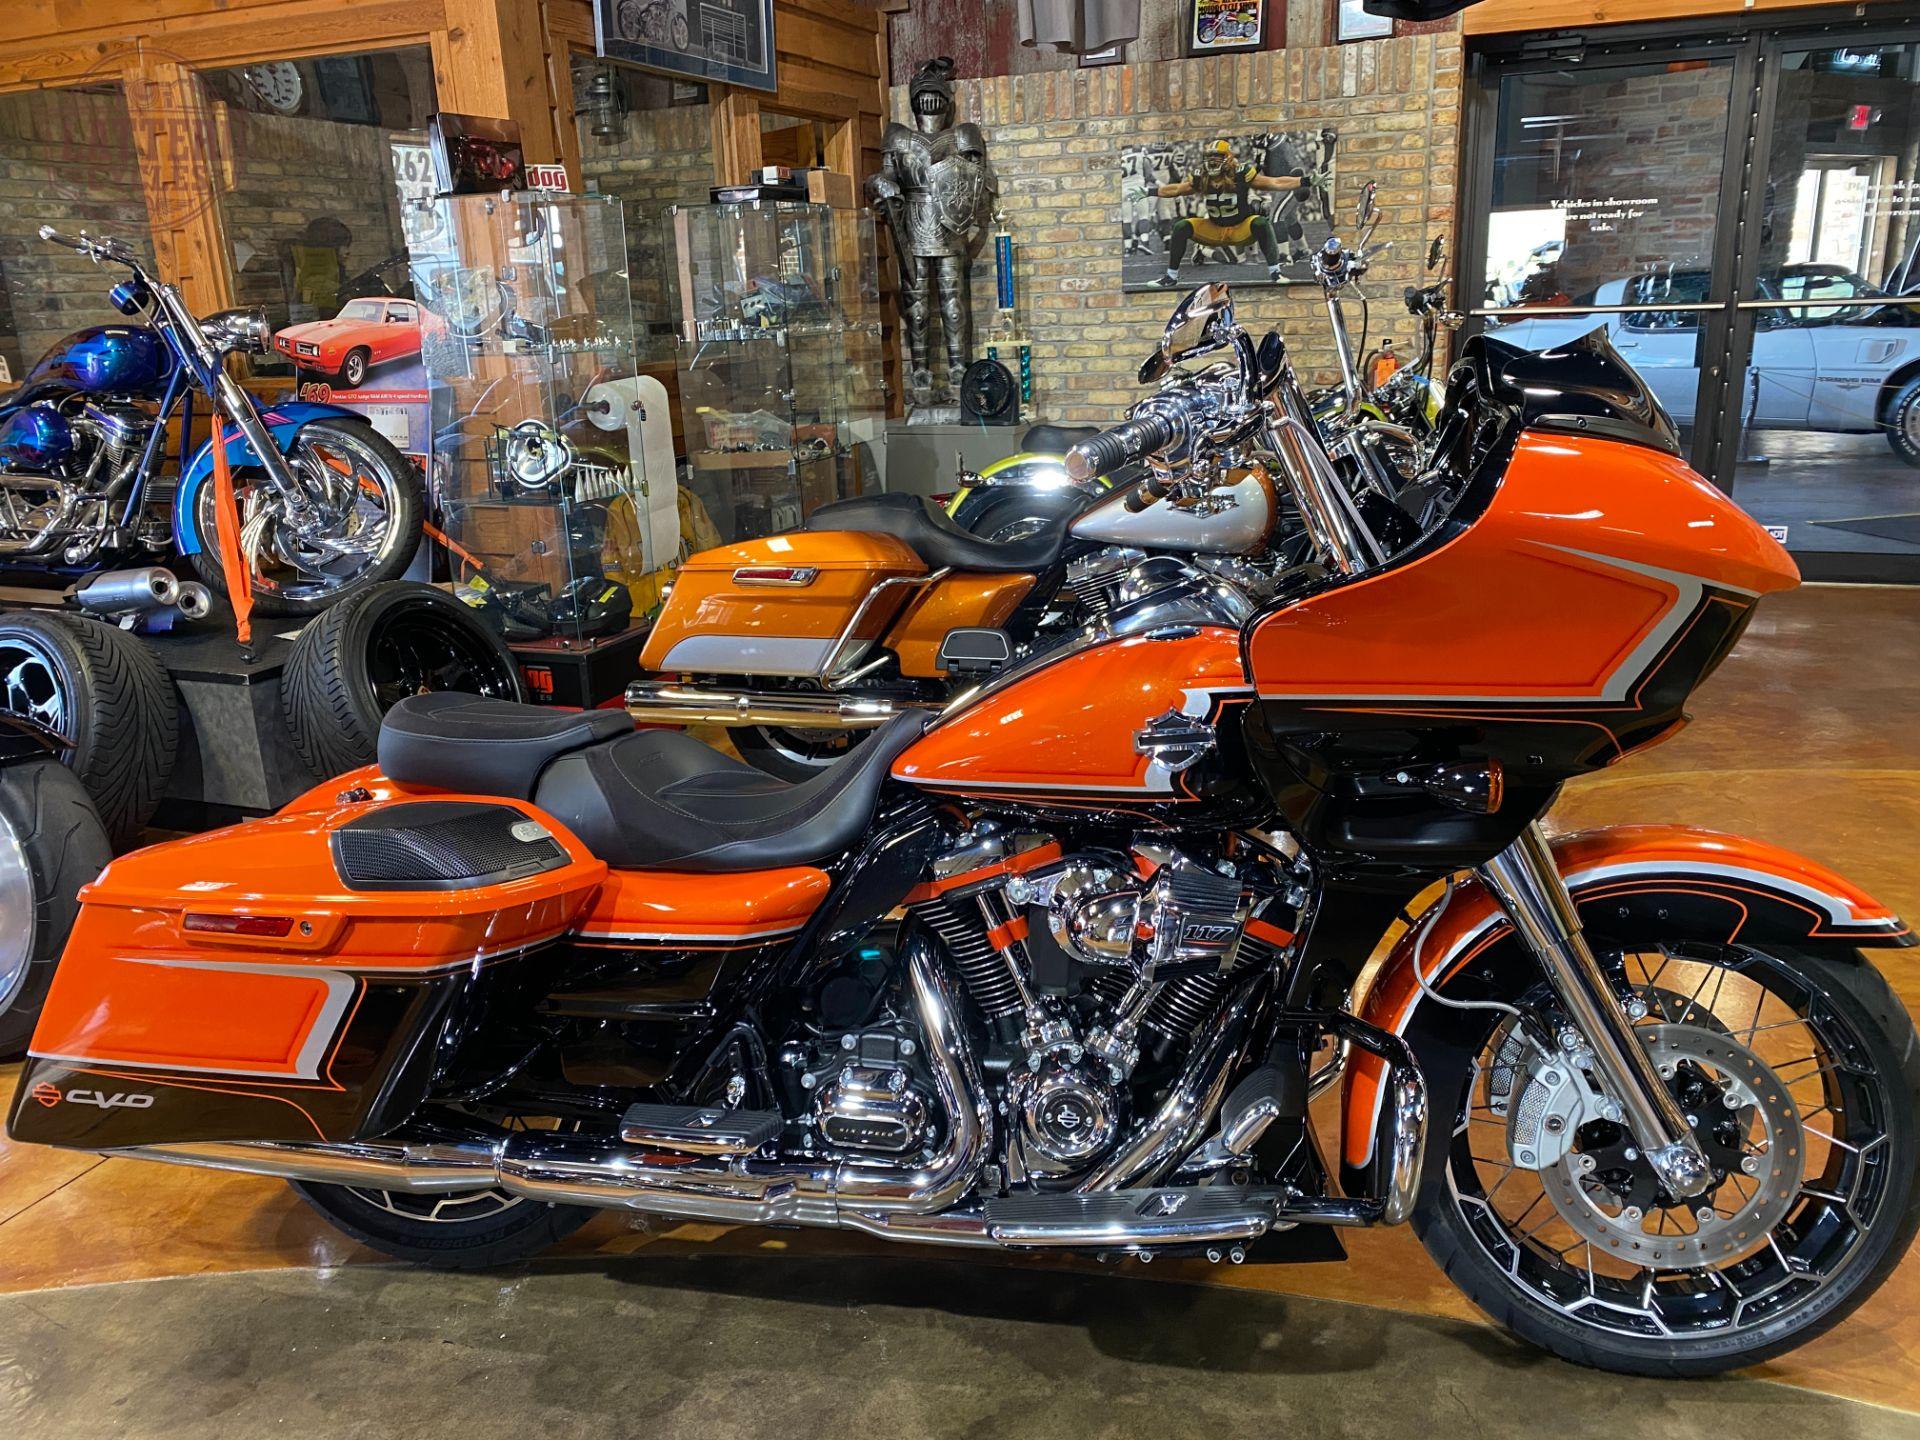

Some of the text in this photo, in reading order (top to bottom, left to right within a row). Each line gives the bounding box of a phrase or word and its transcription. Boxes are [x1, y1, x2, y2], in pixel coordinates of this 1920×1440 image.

[527, 166, 567, 191] dog
[1205, 193, 1239, 218] 52
[1550, 197, 1658, 209] Vehicles in showroom
[1580, 212, 1597, 220] not
[1598, 209, 1626, 220] ready
[1628, 208, 1644, 219] for
[1590, 222, 1614, 232] sale.
[1183, 924, 1234, 941] 117
[65, 1089, 154, 1108] CVO
